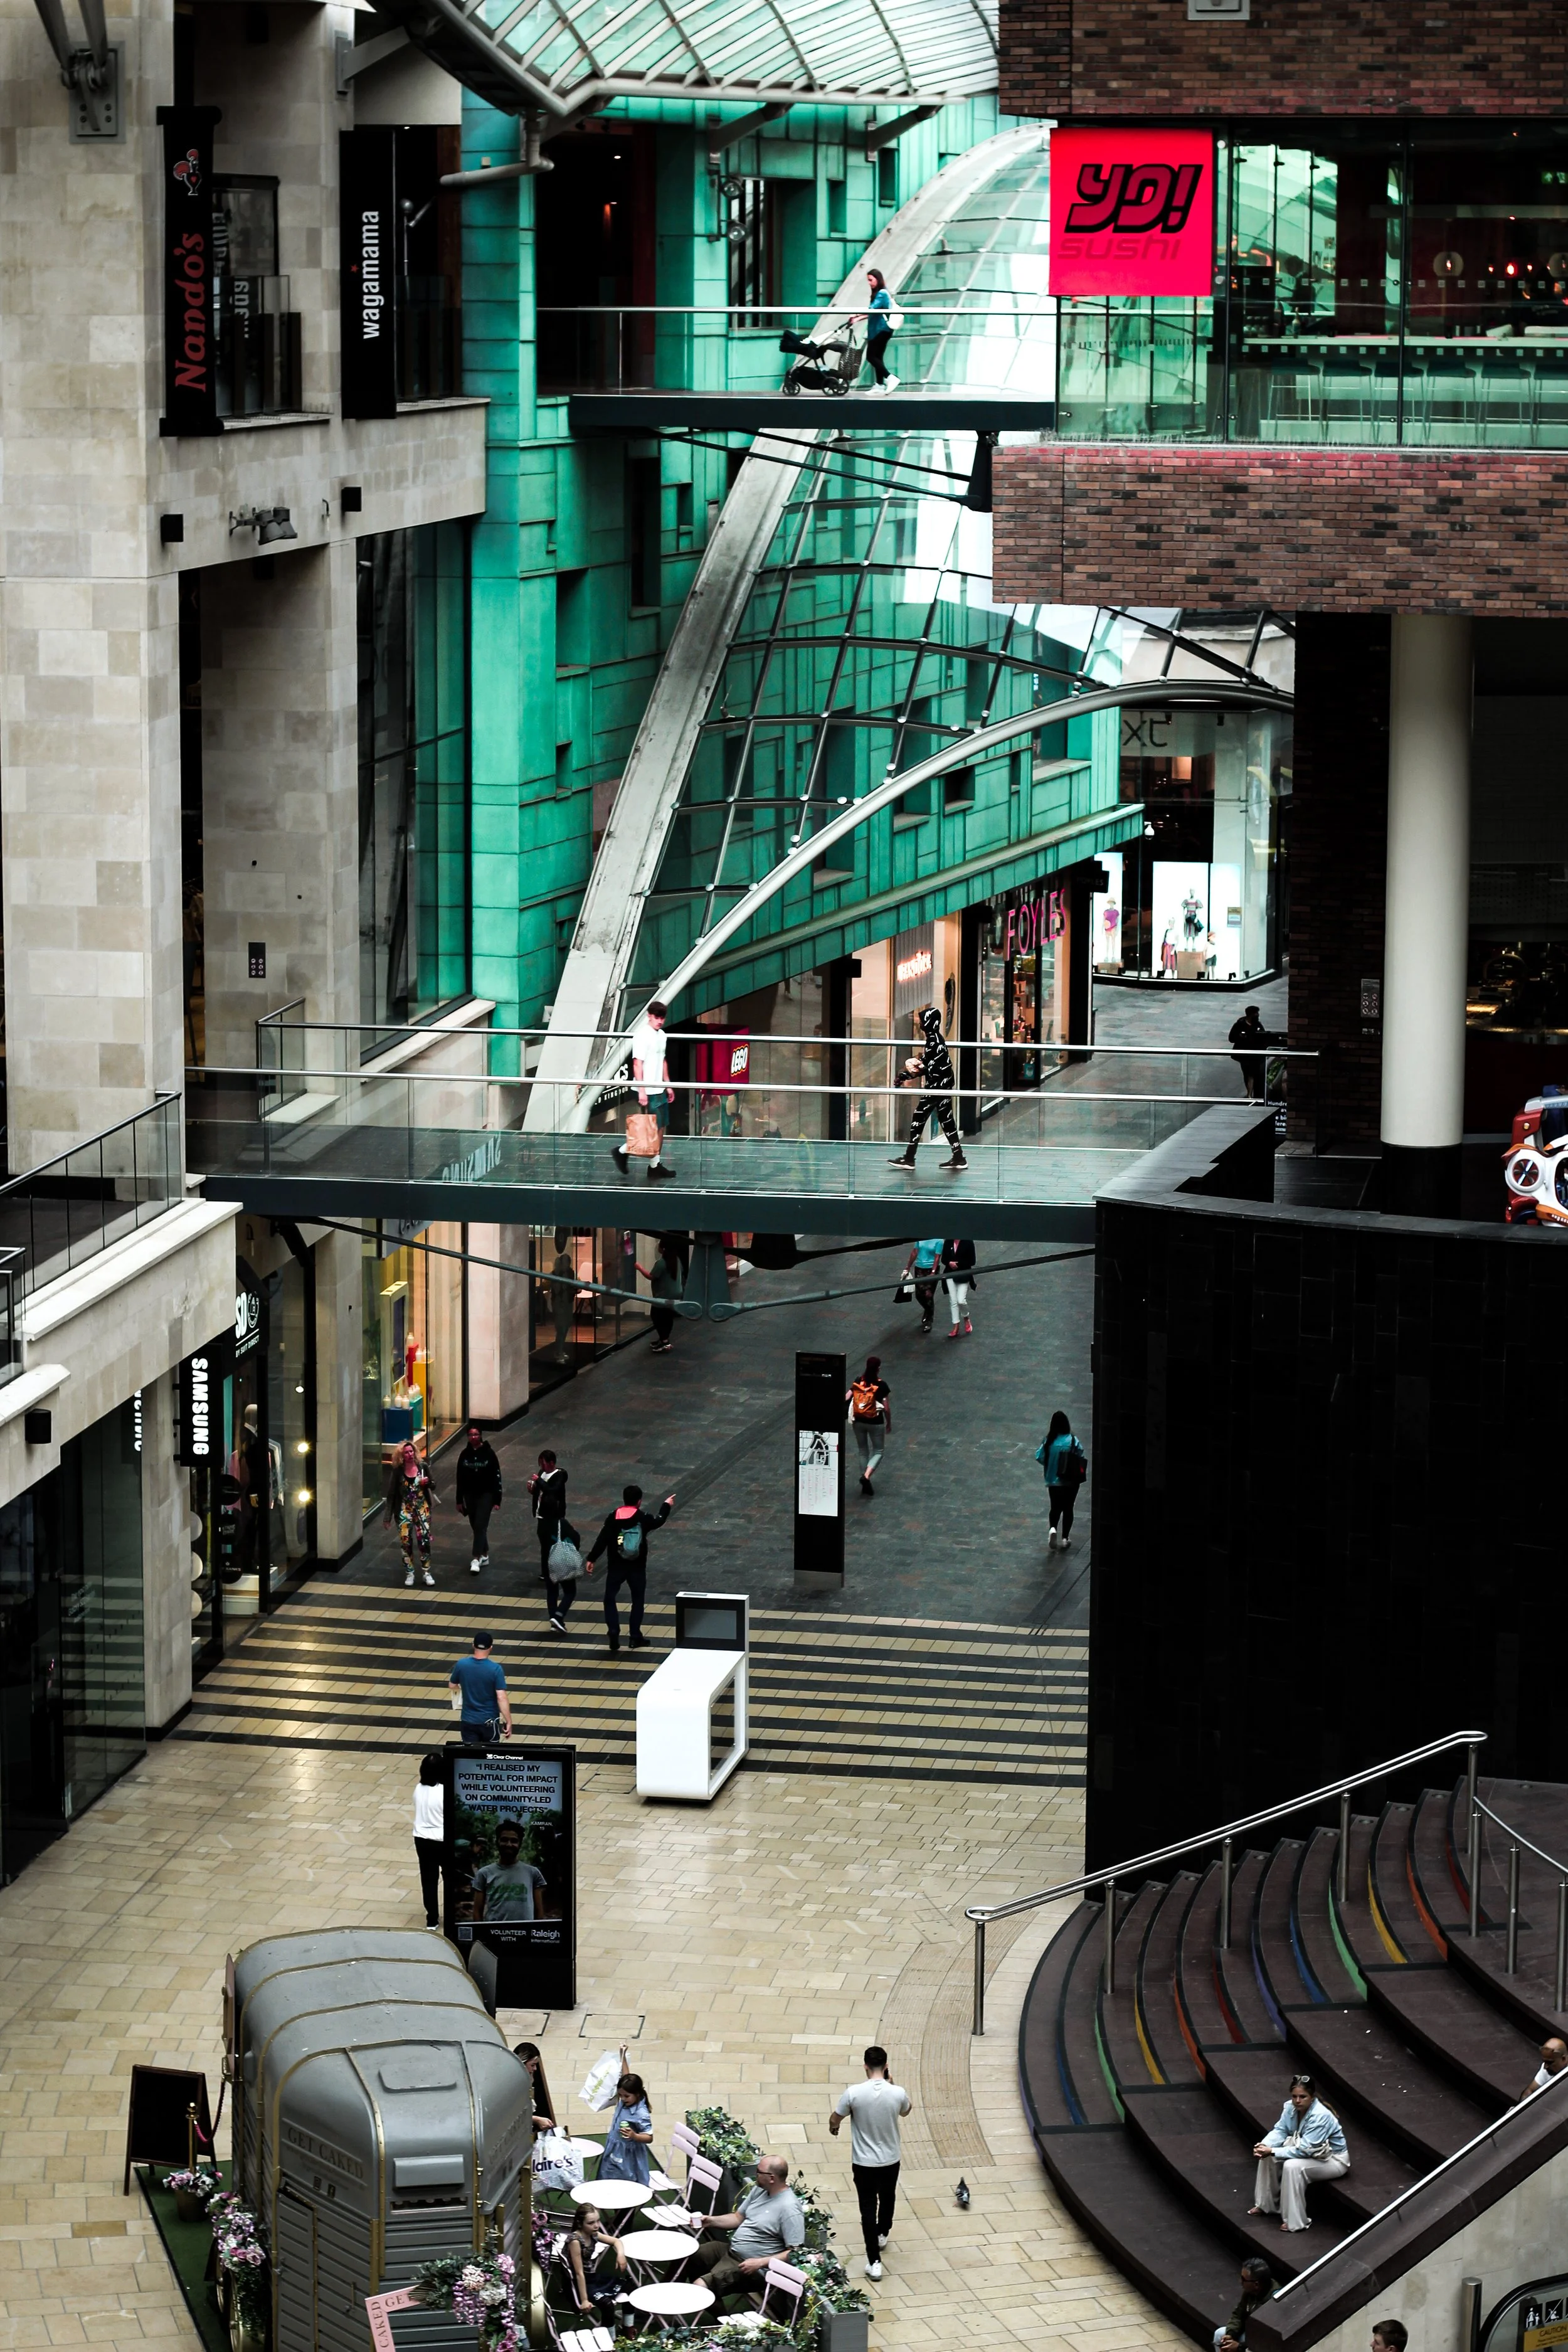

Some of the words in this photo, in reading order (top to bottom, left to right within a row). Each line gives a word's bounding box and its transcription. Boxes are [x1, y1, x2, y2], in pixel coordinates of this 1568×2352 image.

[1064, 164, 1204, 233] YO!
[1057, 234, 1180, 260] sushi
[363, 211, 384, 339] wagamama
[174, 233, 206, 392] Nando's
[1121, 719, 1171, 747] xt
[1007, 888, 1066, 961] FOYLES
[731, 1046, 748, 1074] LEGO
[235, 1291, 247, 1339] SD
[191, 1358, 209, 1455] SAMSUNG
[458, 1773, 505, 1781] POTENTIAL
[484, 1764, 525, 1772] REALISED
[461, 1783, 489, 1791] WHILE
[489, 1784, 555, 1793] VOLUNTEERING
[480, 1794, 551, 1803] COMMUNITY-LED
[531, 1929, 560, 1939] Raleigh
[288, 2127, 313, 2153] GET
[319, 2144, 364, 2179] CAKED
[532, 2155, 573, 2173] laire's
[371, 2301, 389, 2348] CAKED
